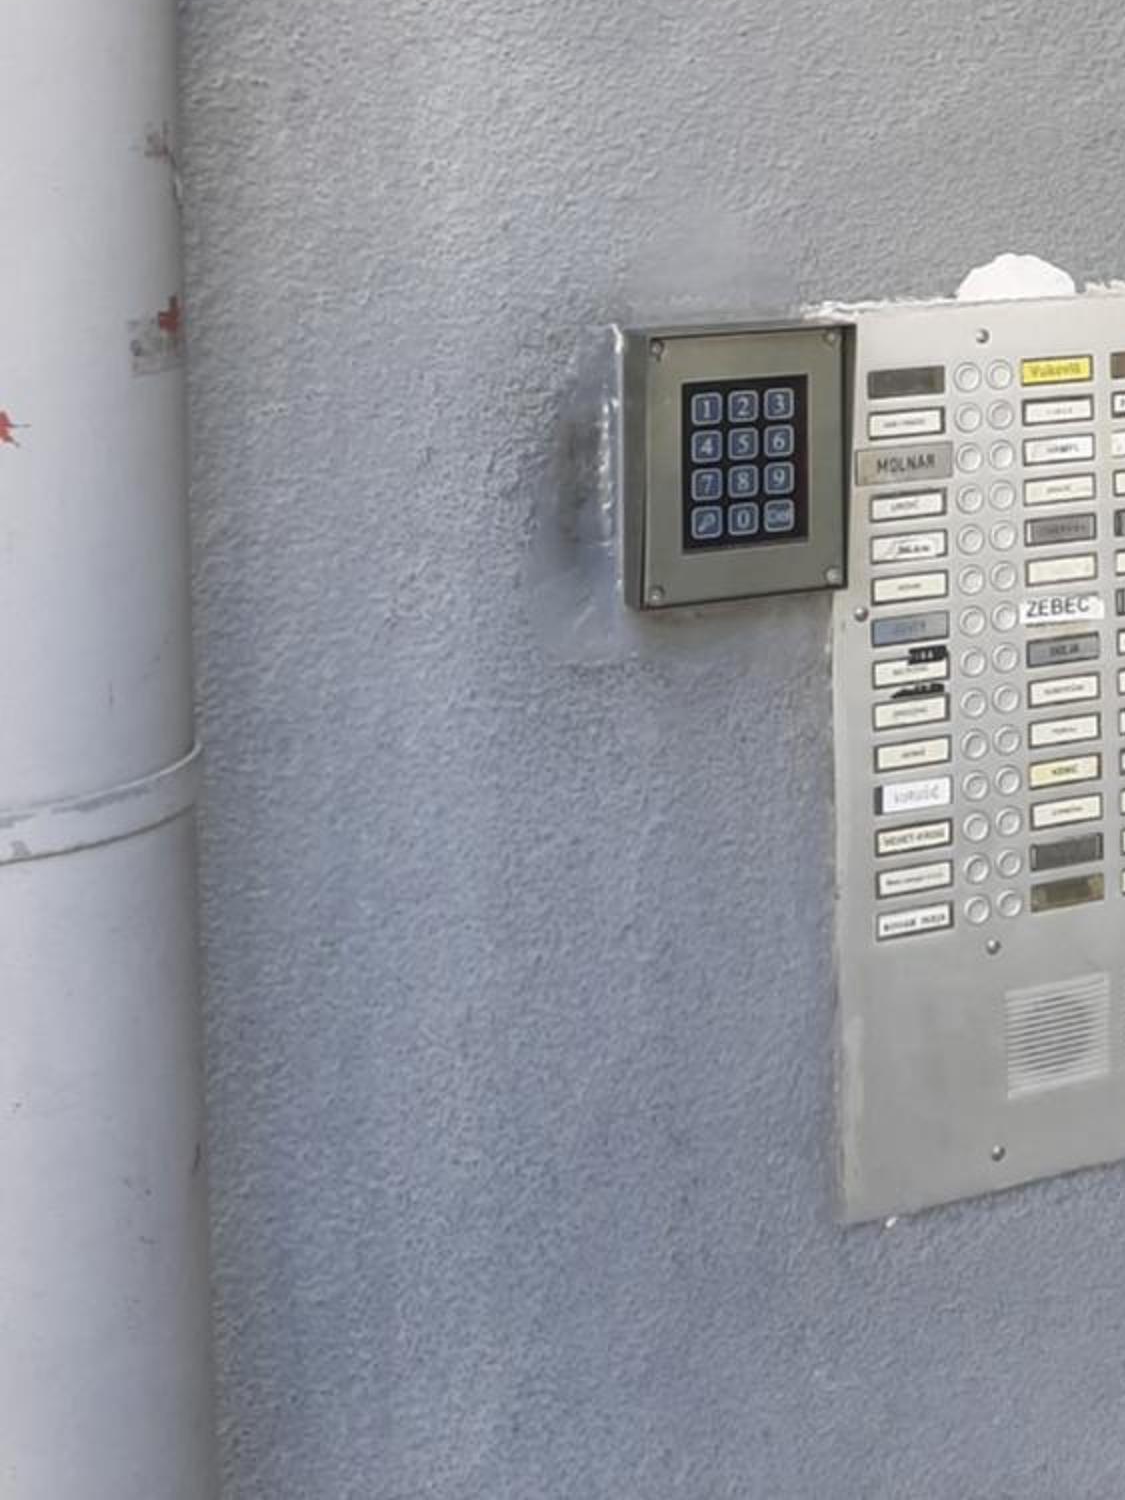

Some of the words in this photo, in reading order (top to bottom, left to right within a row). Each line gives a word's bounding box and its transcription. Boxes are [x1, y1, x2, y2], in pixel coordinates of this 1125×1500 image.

[702, 400, 712, 419] 1
[737, 397, 750, 417] 2
[773, 393, 785, 414] 3
[701, 436, 714, 456] 4
[738, 433, 750, 454] 5
[772, 430, 785, 450] 6
[876, 452, 936, 474] MOLNAR
[701, 473, 714, 495] 7
[737, 471, 750, 491] 8
[772, 468, 785, 488] 9
[737, 509, 750, 529] 0
[1026, 596, 1090, 618] ZEBEC
